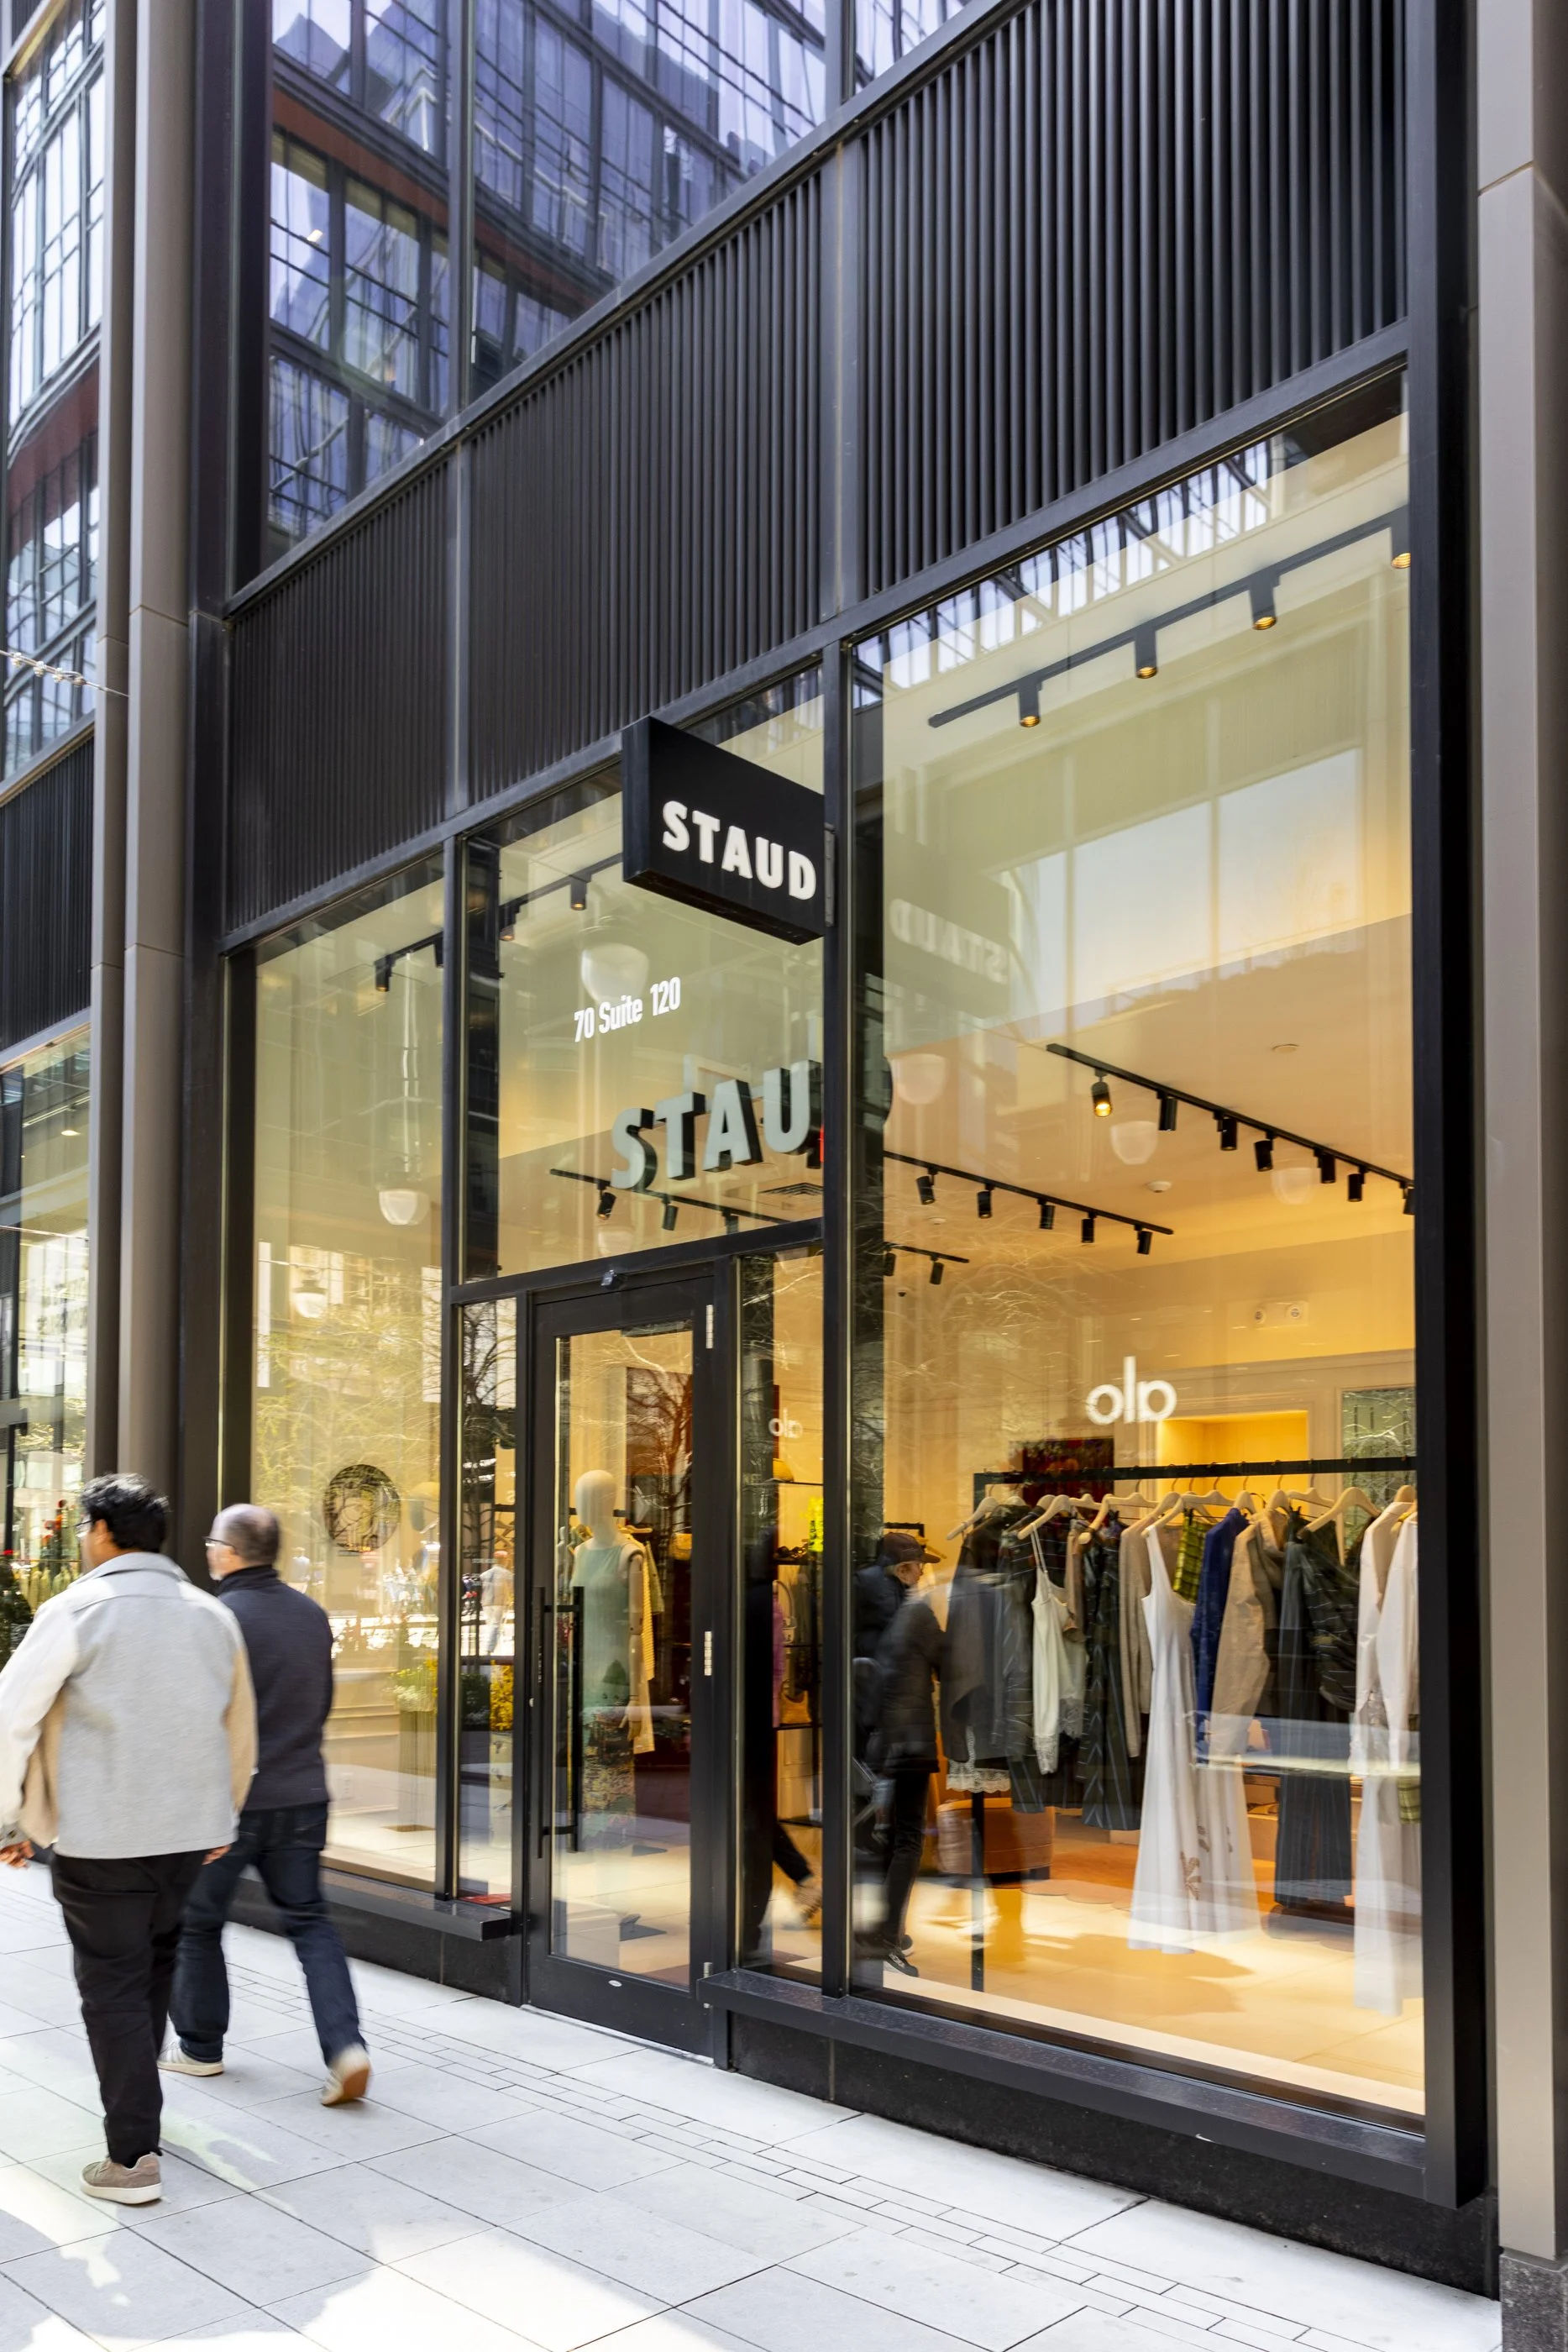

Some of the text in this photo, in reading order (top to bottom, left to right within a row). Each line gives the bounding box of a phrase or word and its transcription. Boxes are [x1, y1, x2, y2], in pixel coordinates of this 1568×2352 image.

[662, 801, 816, 900] STAUD
[574, 976, 681, 1042] 70 Suite 120
[611, 1057, 892, 1191] STAU
